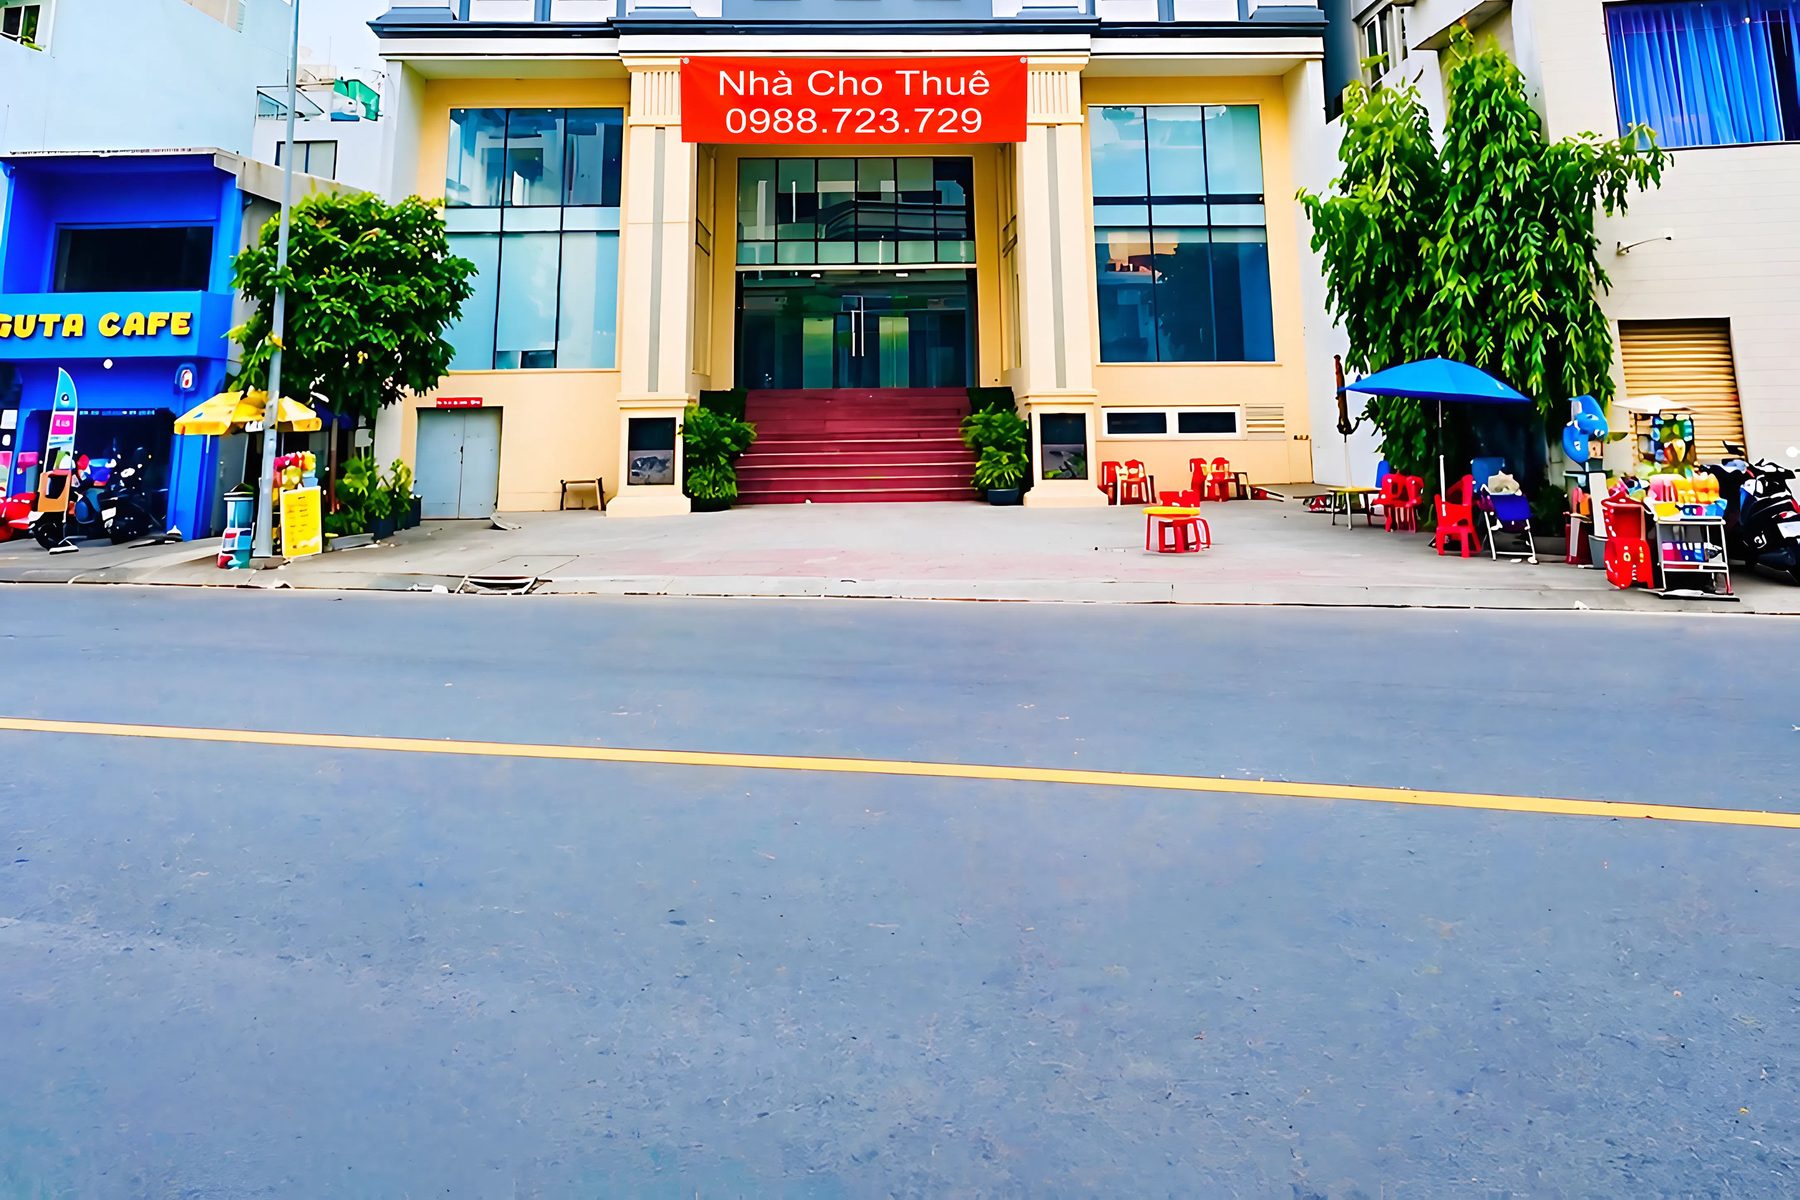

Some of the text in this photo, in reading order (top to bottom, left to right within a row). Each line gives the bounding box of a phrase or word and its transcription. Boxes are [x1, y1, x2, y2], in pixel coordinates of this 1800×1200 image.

[718, 69, 990, 96] Nhà Cho Thuê
[725, 107, 982, 134] 0988.723.729
[98, 311, 191, 337] CAFE
